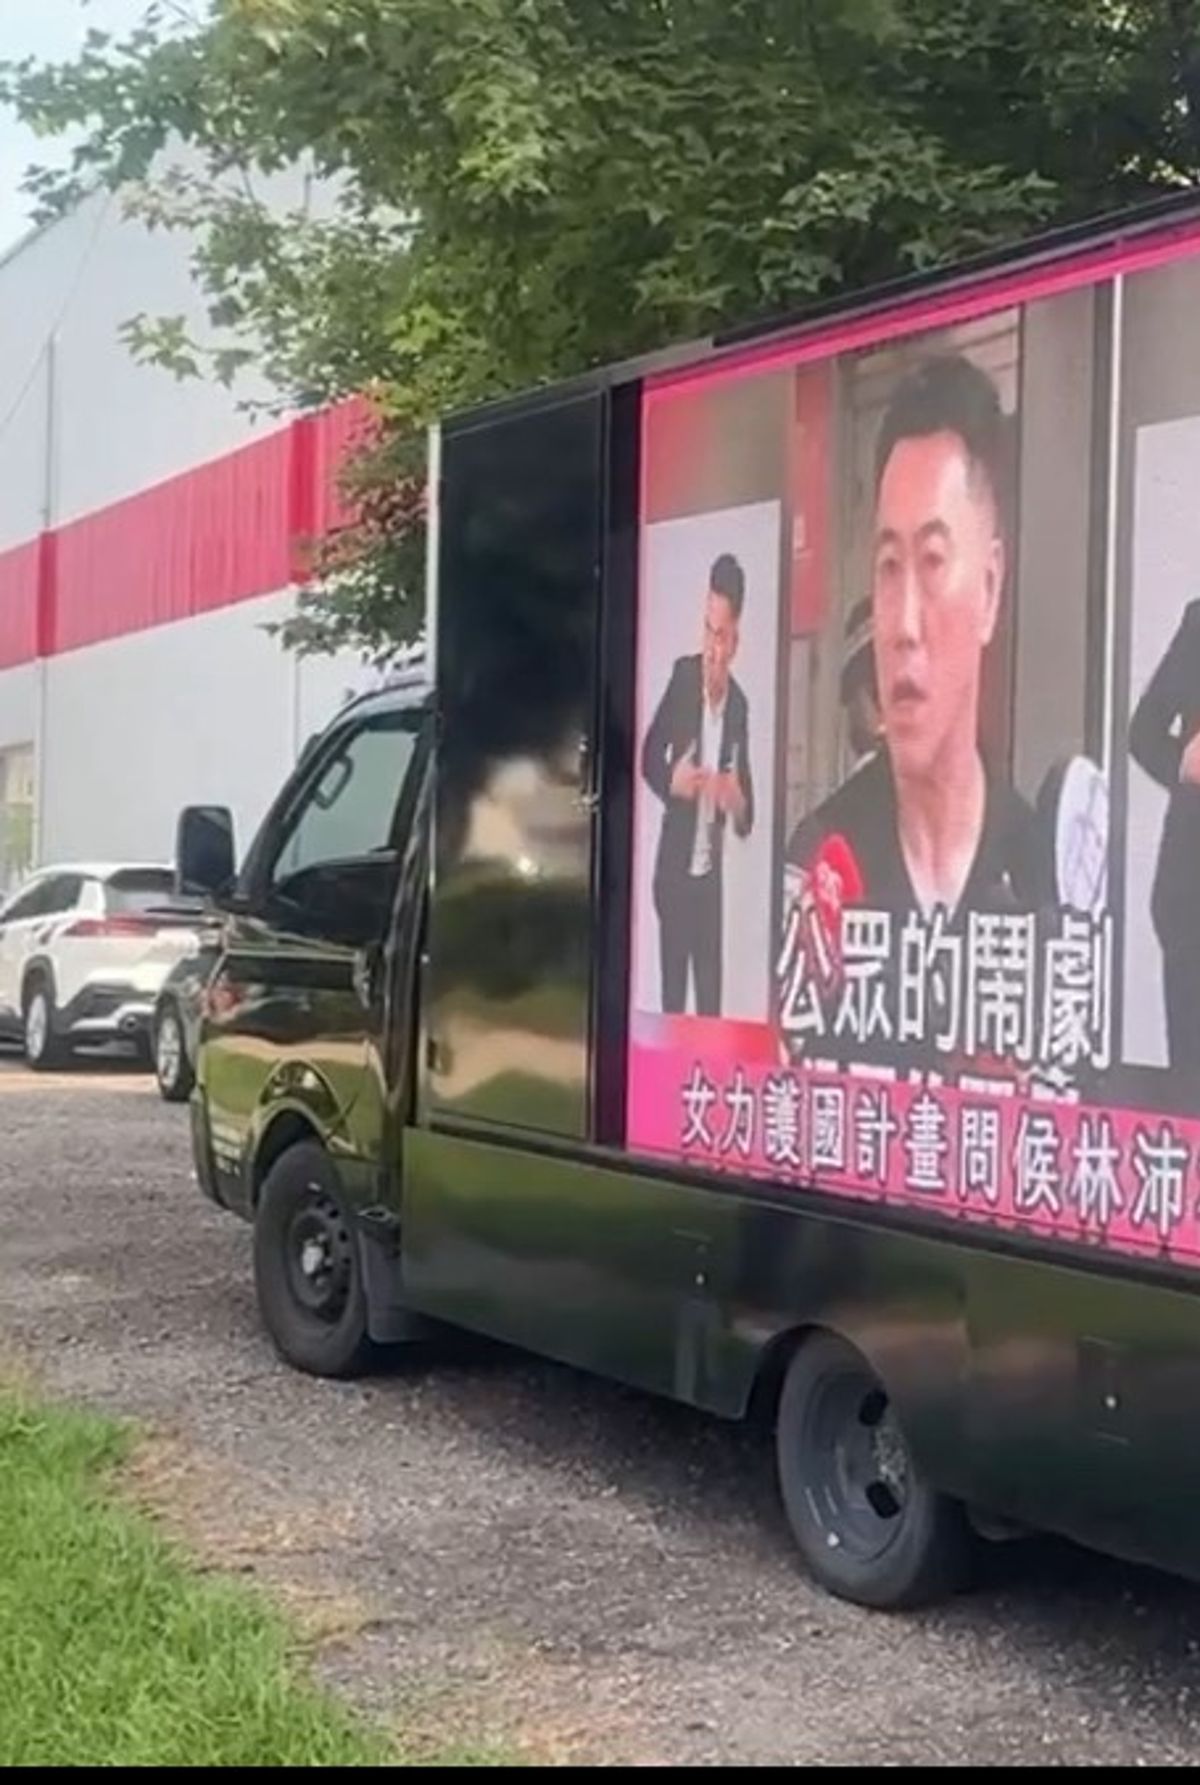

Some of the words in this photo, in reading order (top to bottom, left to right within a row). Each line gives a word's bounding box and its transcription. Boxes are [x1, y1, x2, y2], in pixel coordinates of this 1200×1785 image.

[776, 904, 1113, 1069] 公眾的鬧劇
